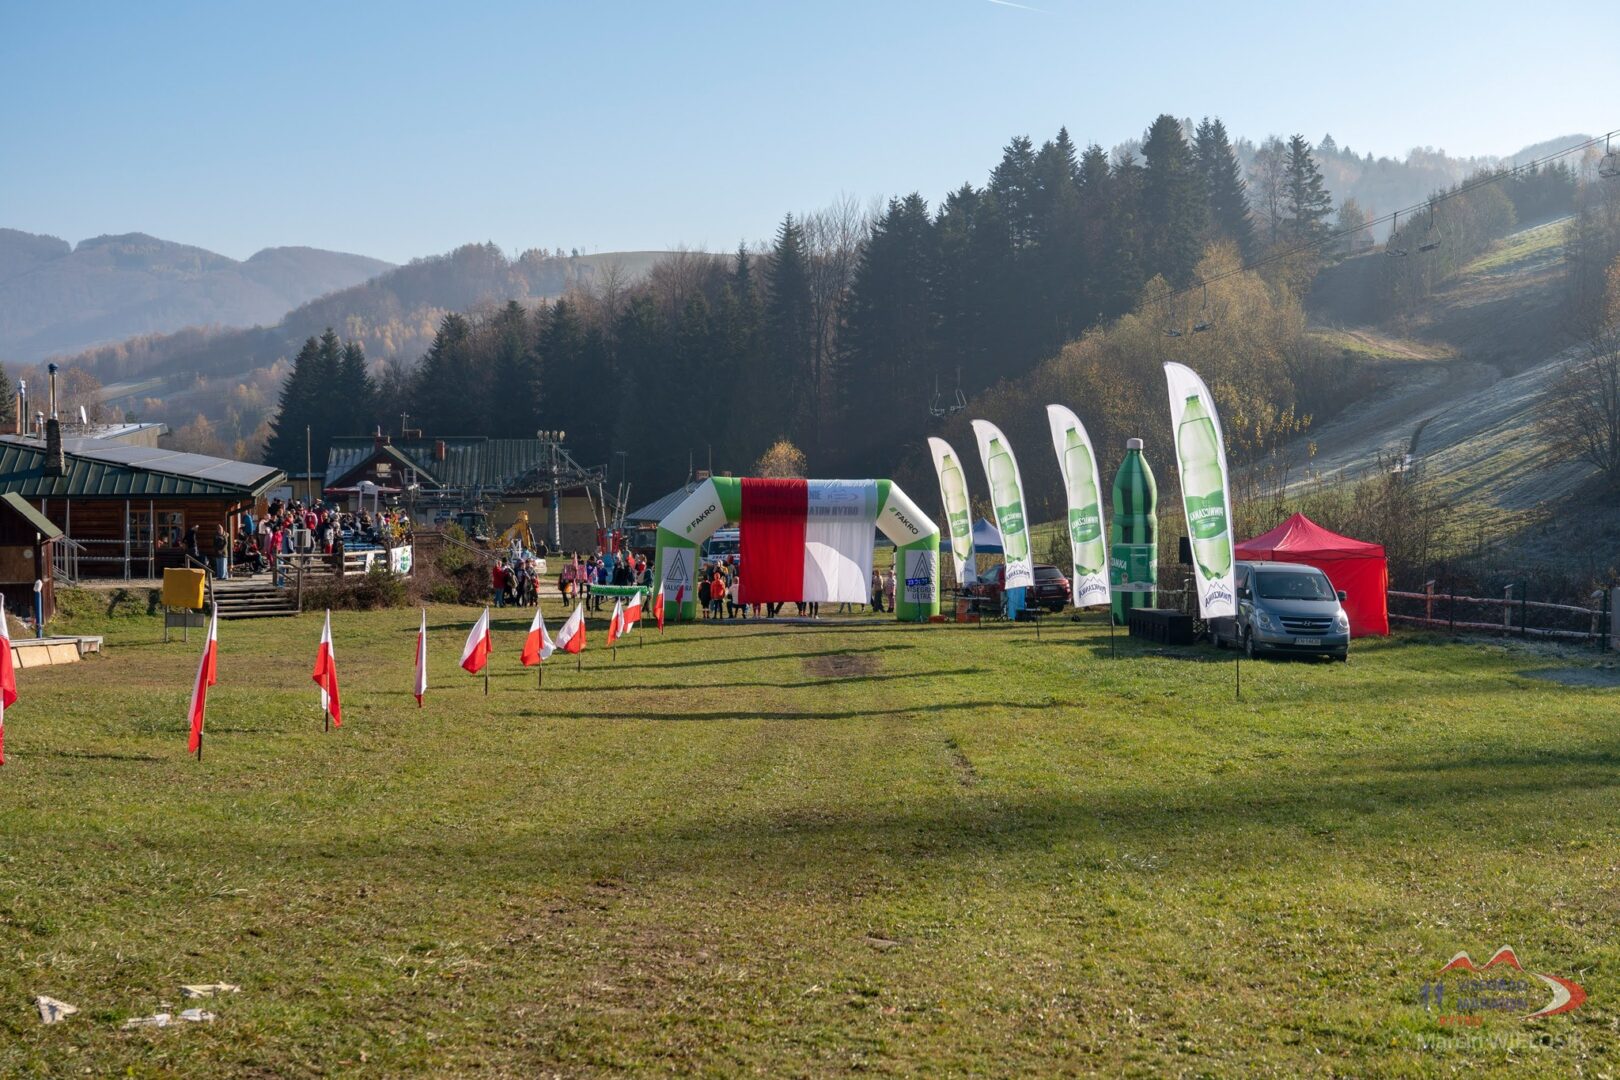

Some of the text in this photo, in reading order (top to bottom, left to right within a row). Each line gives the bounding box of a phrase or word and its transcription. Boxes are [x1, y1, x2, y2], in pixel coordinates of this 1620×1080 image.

[691, 503, 717, 529] FAKRO
[894, 511, 920, 535] FAKRO
[664, 583, 693, 592] ALIRA
